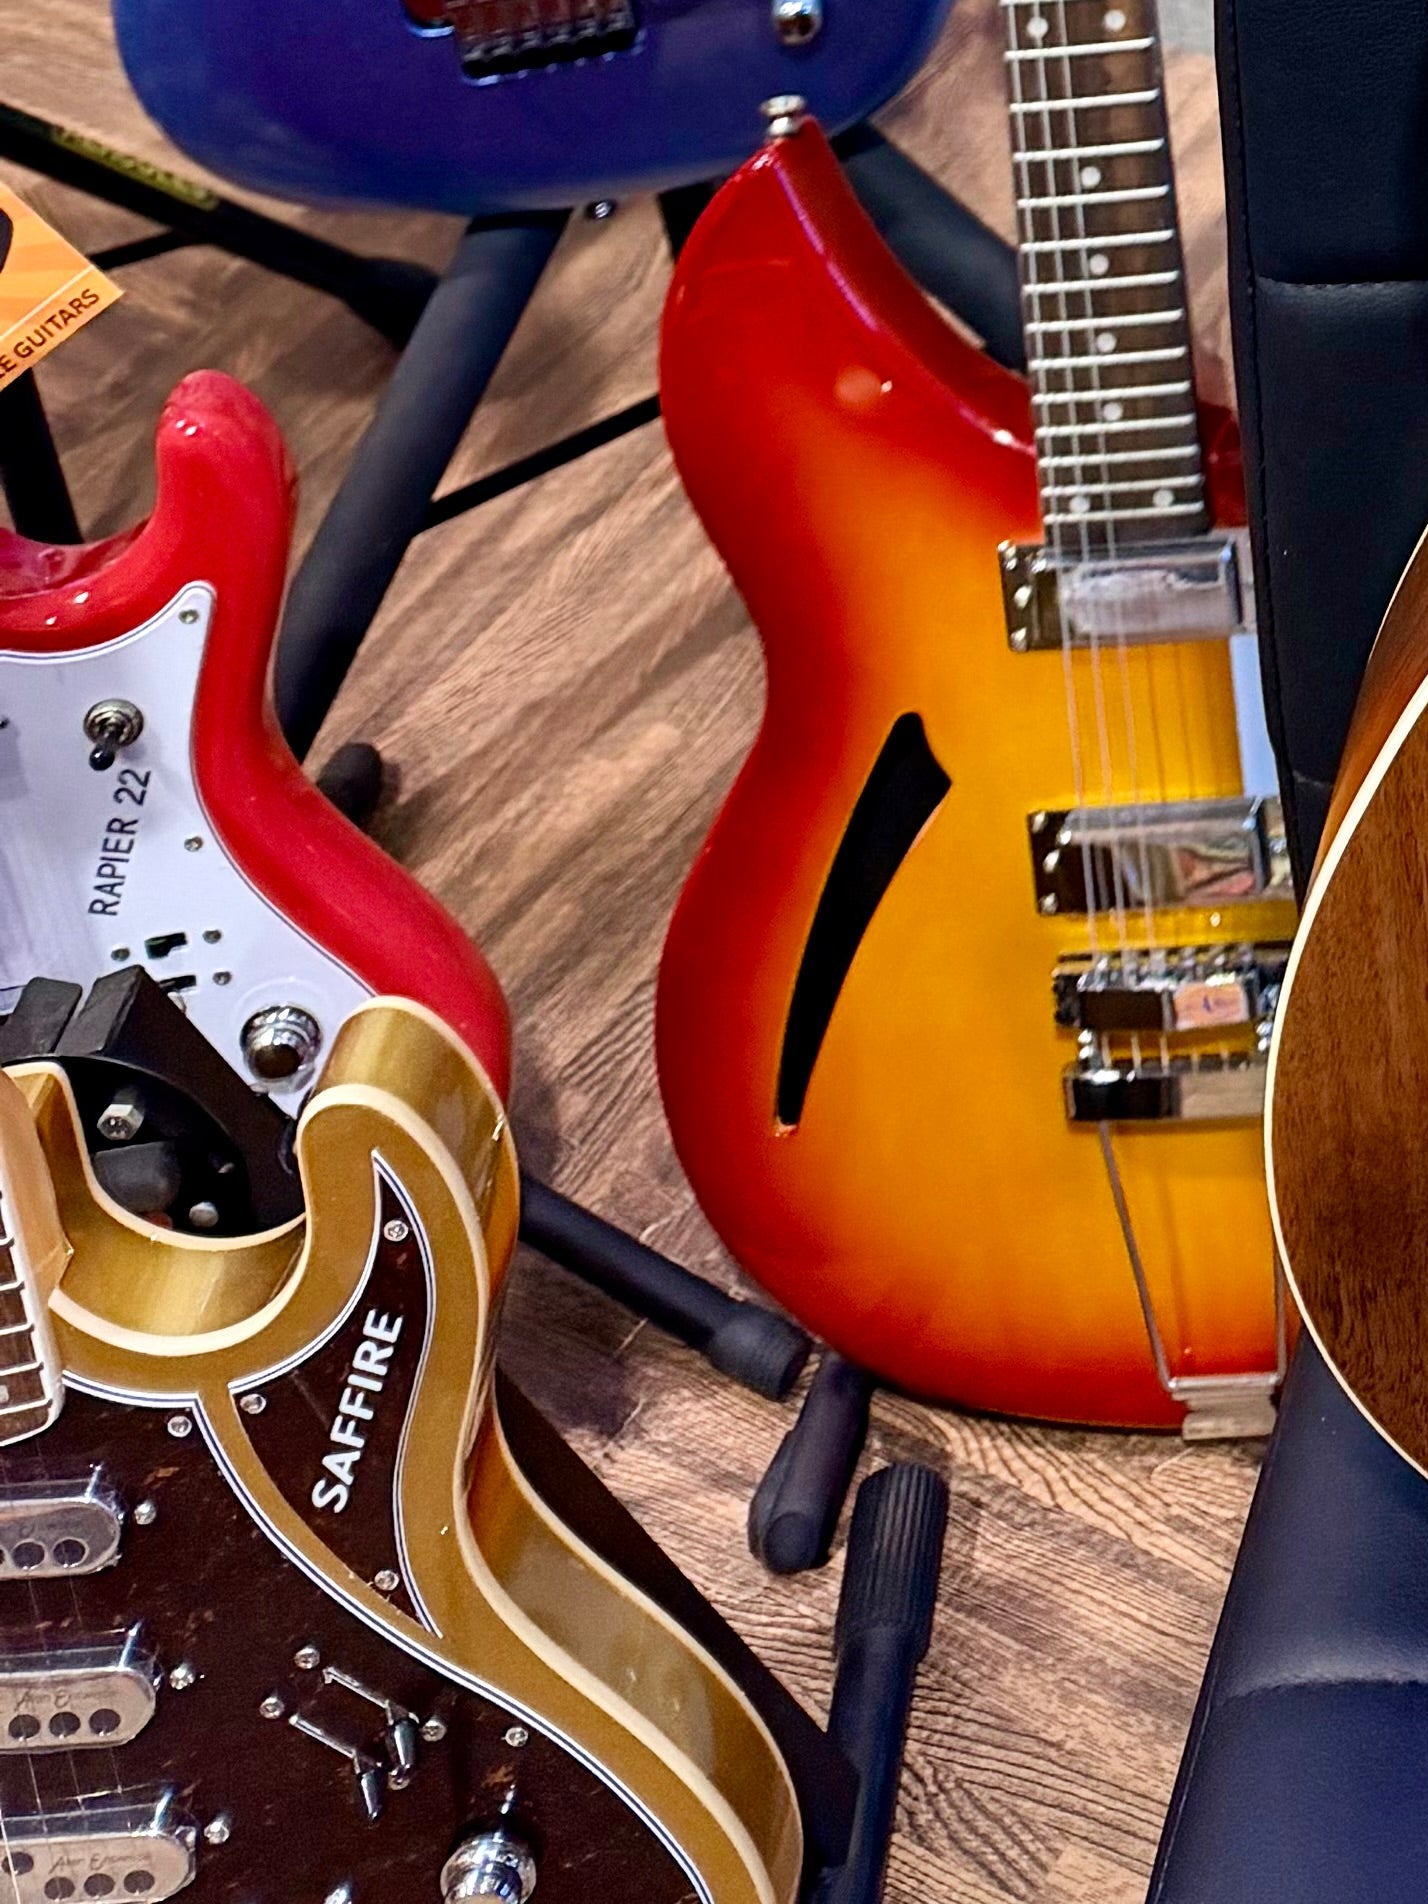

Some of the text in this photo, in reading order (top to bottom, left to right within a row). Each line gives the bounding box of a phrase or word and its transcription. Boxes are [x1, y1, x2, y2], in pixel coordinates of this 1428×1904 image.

[13, 288, 100, 359] GUITARS
[87, 768, 152, 917] RAPIER 22
[311, 1308, 406, 1515] SAFFIRE
